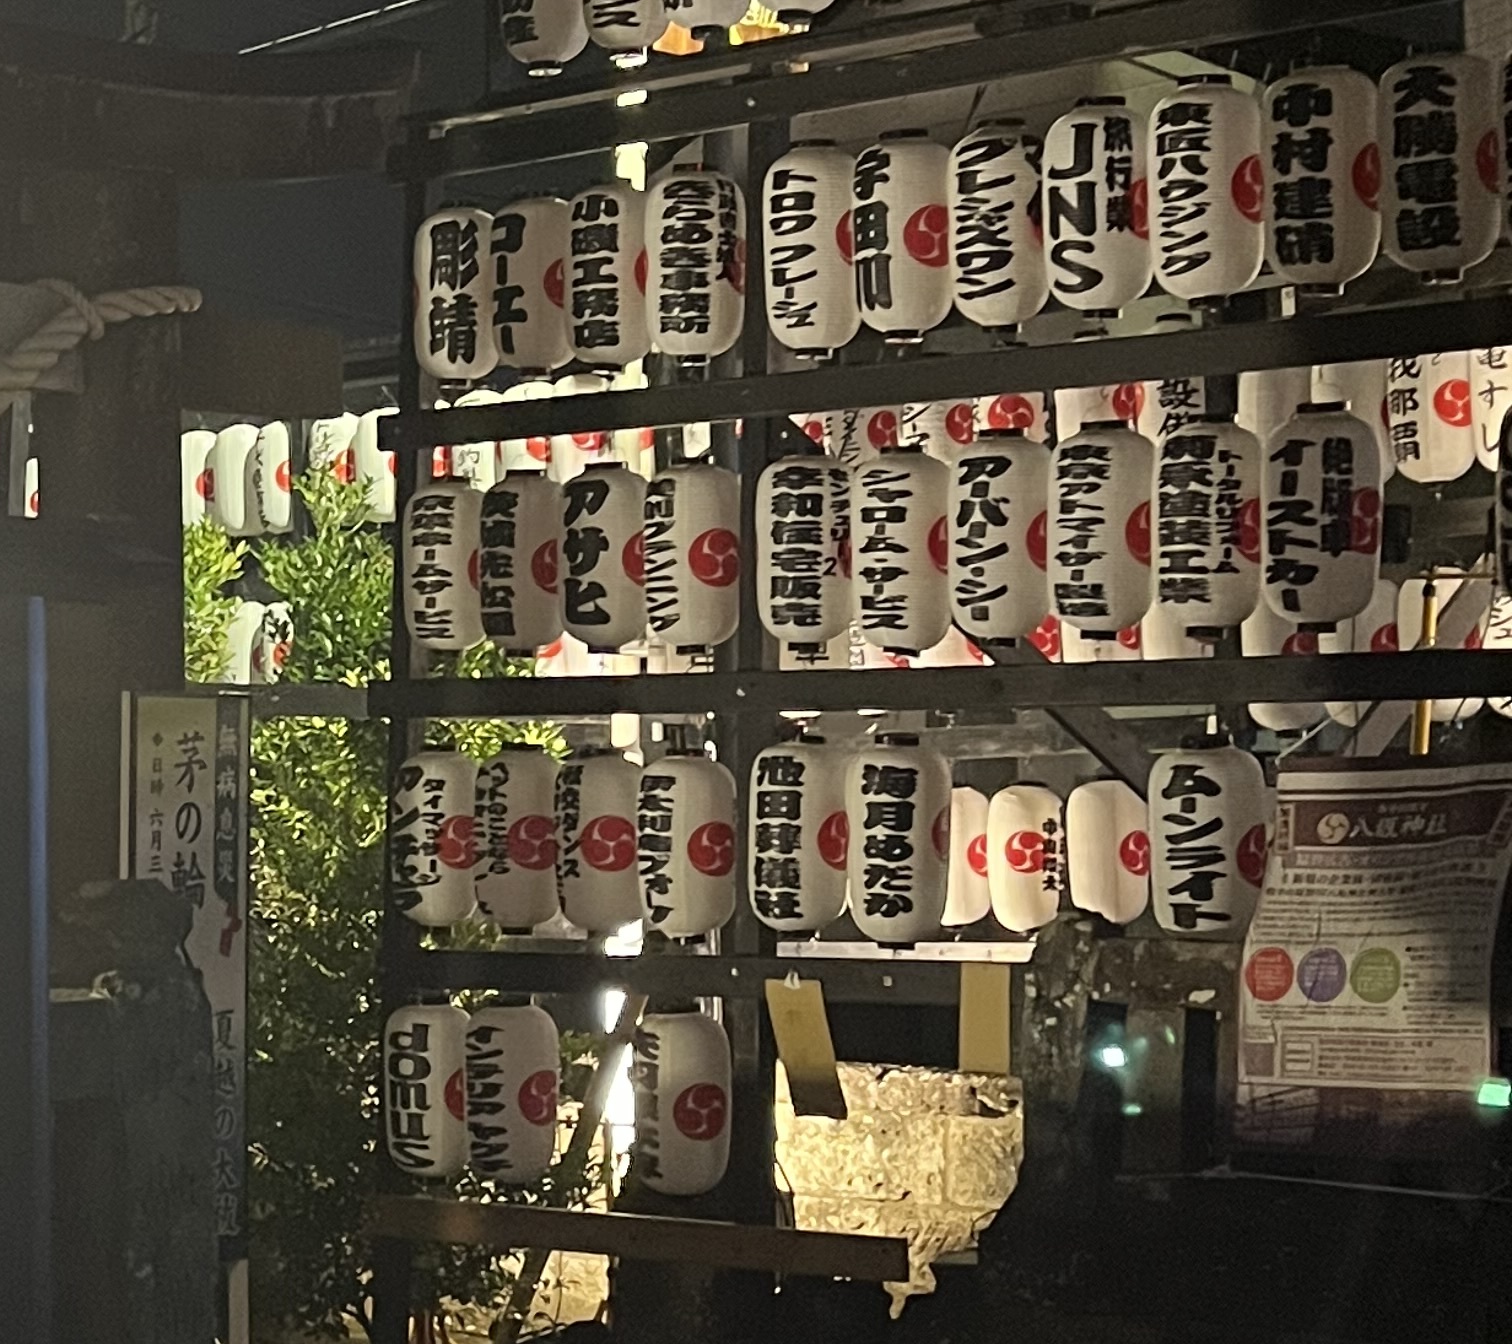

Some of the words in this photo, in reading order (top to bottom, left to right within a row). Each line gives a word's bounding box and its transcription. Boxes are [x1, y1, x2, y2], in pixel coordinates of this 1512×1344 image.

[1048, 123, 1104, 294] JNS
[862, 764, 920, 919] 海月めだか
[1162, 764, 1231, 930] ムーンライト
